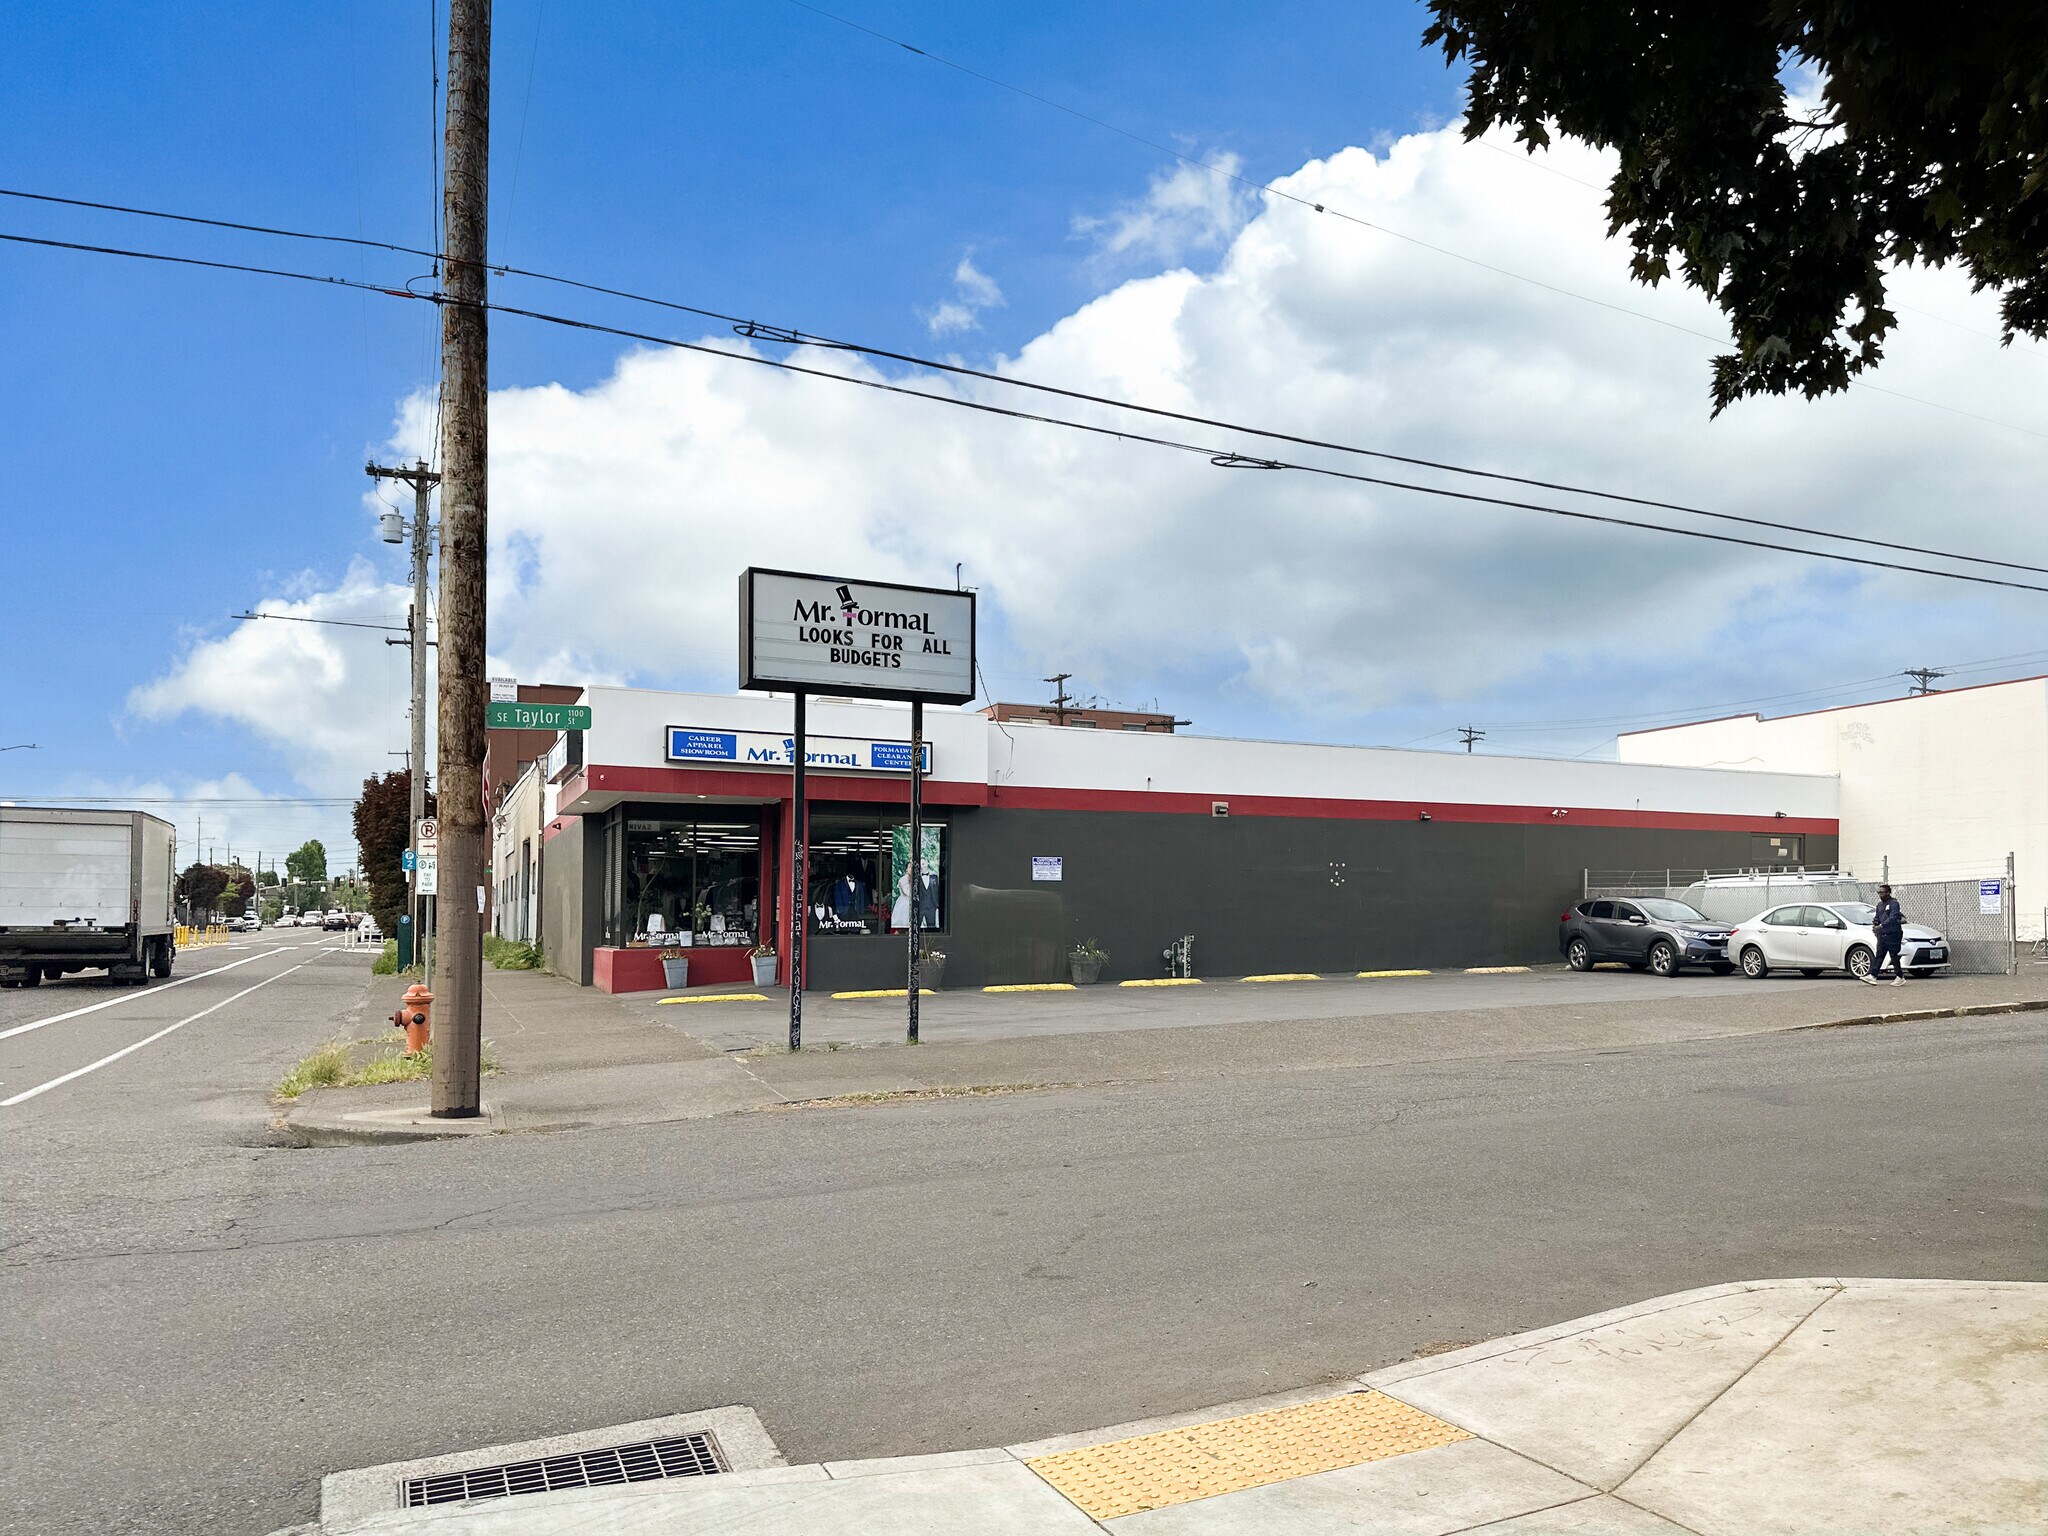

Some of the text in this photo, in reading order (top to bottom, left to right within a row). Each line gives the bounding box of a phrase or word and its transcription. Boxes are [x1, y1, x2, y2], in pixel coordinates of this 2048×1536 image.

[793, 598, 836, 624] Mr.
[799, 626, 952, 656] LOOKS FOR ALL
[830, 647, 901, 669] BUDGETS
[496, 709, 561, 727] SE Taylor
[567, 709, 584, 718] 1100
[567, 717, 575, 725] St
[688, 735, 722, 743] CAREER
[686, 742, 724, 750] APPAREL
[680, 748, 729, 757] SHOWROOM
[747, 747, 781, 762] Mr.
[876, 752, 912, 761] CLEARAN
[818, 920, 834, 929] Mr.
[633, 932, 649, 941] Mr.
[702, 930, 716, 939] Mr.
